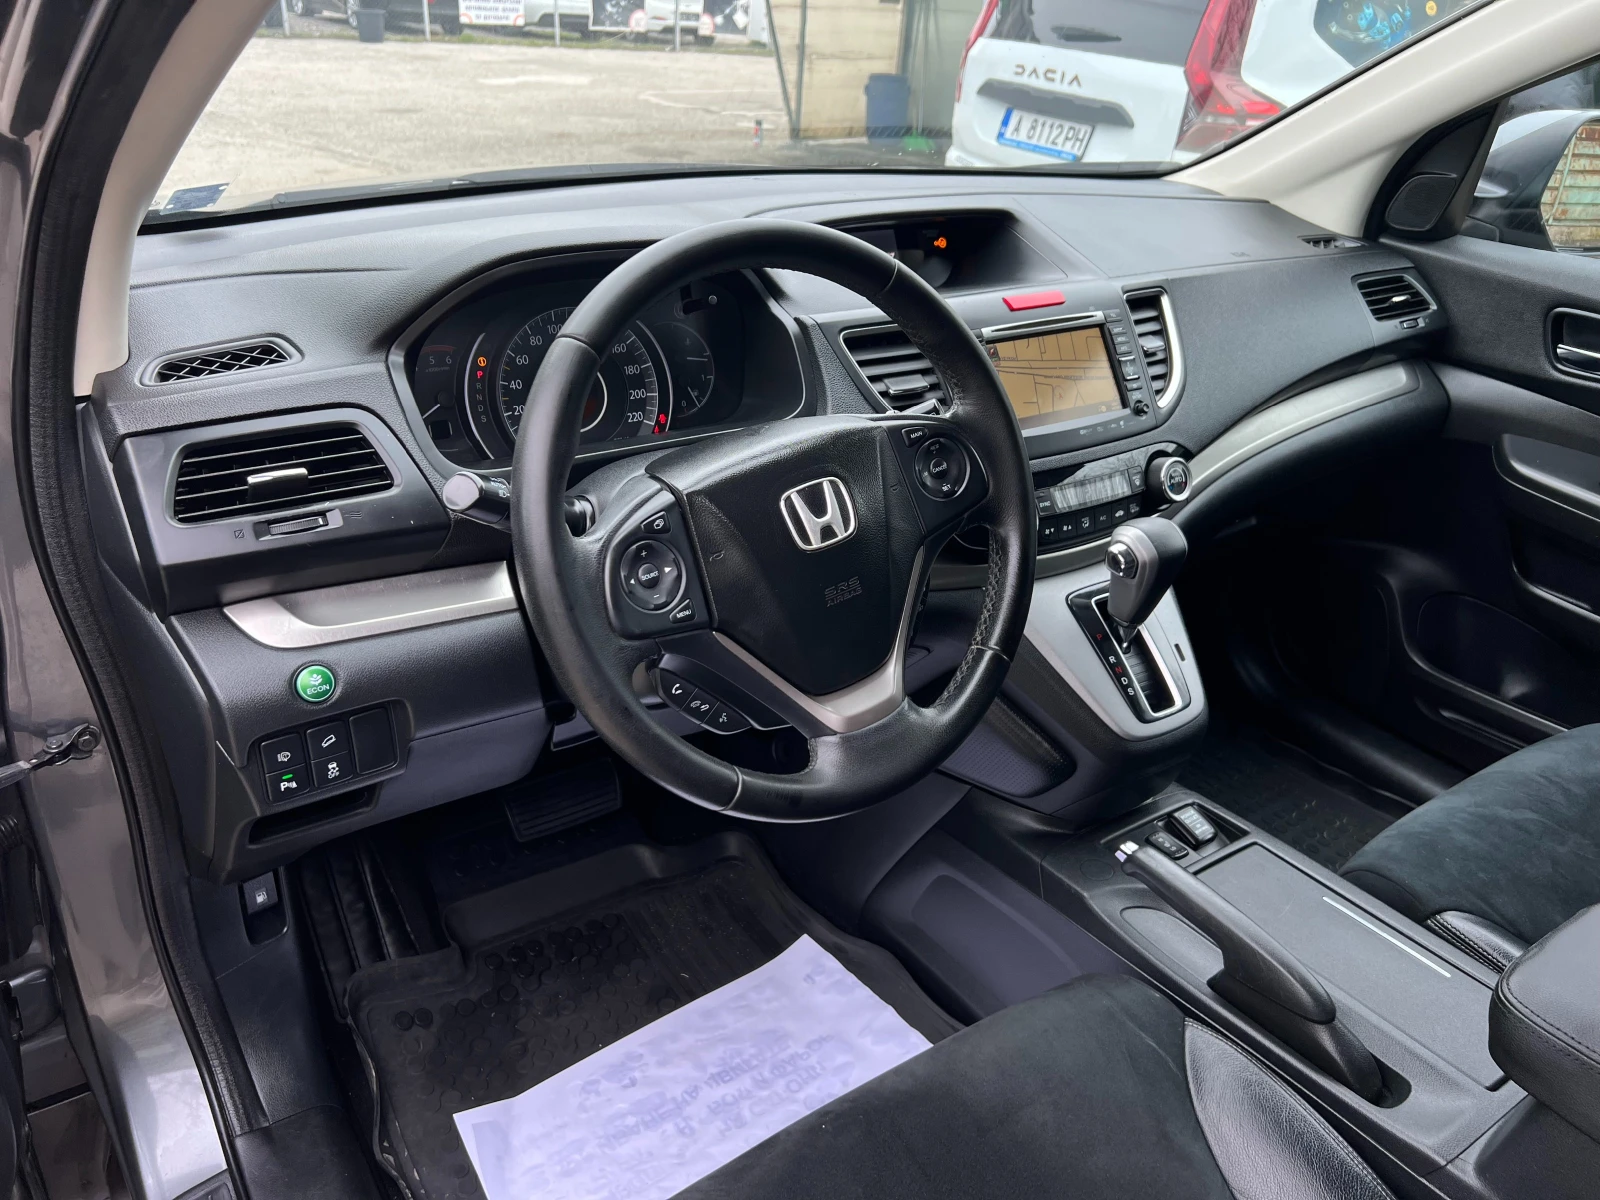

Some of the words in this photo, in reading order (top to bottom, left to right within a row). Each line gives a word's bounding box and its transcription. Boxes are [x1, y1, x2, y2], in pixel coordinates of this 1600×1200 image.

[1014, 64, 1082, 88] DACIA
[1011, 115, 1023, 138] A
[530, 335, 543, 346] 80
[429, 356, 435, 365] 5
[445, 355, 452, 365] 6
[516, 354, 529, 365] 60
[476, 370, 484, 379] P
[624, 364, 641, 375] 180
[476, 382, 482, 390] R
[509, 379, 523, 390] 40
[629, 388, 647, 400] 200
[478, 404, 484, 412] D
[627, 411, 644, 423] 220
[910, 431, 923, 439] MAIN
[932, 462, 948, 474] CANCEL
[641, 570, 660, 581] SOURCE
[824, 575, 860, 599] SRS
[676, 609, 692, 619] MENU
[1096, 633, 1103, 641] P
[1108, 655, 1117, 664] R
[1114, 665, 1123, 674] N
[1120, 676, 1128, 685] D
[1127, 687, 1135, 696] S
[306, 683, 330, 695] ECON
